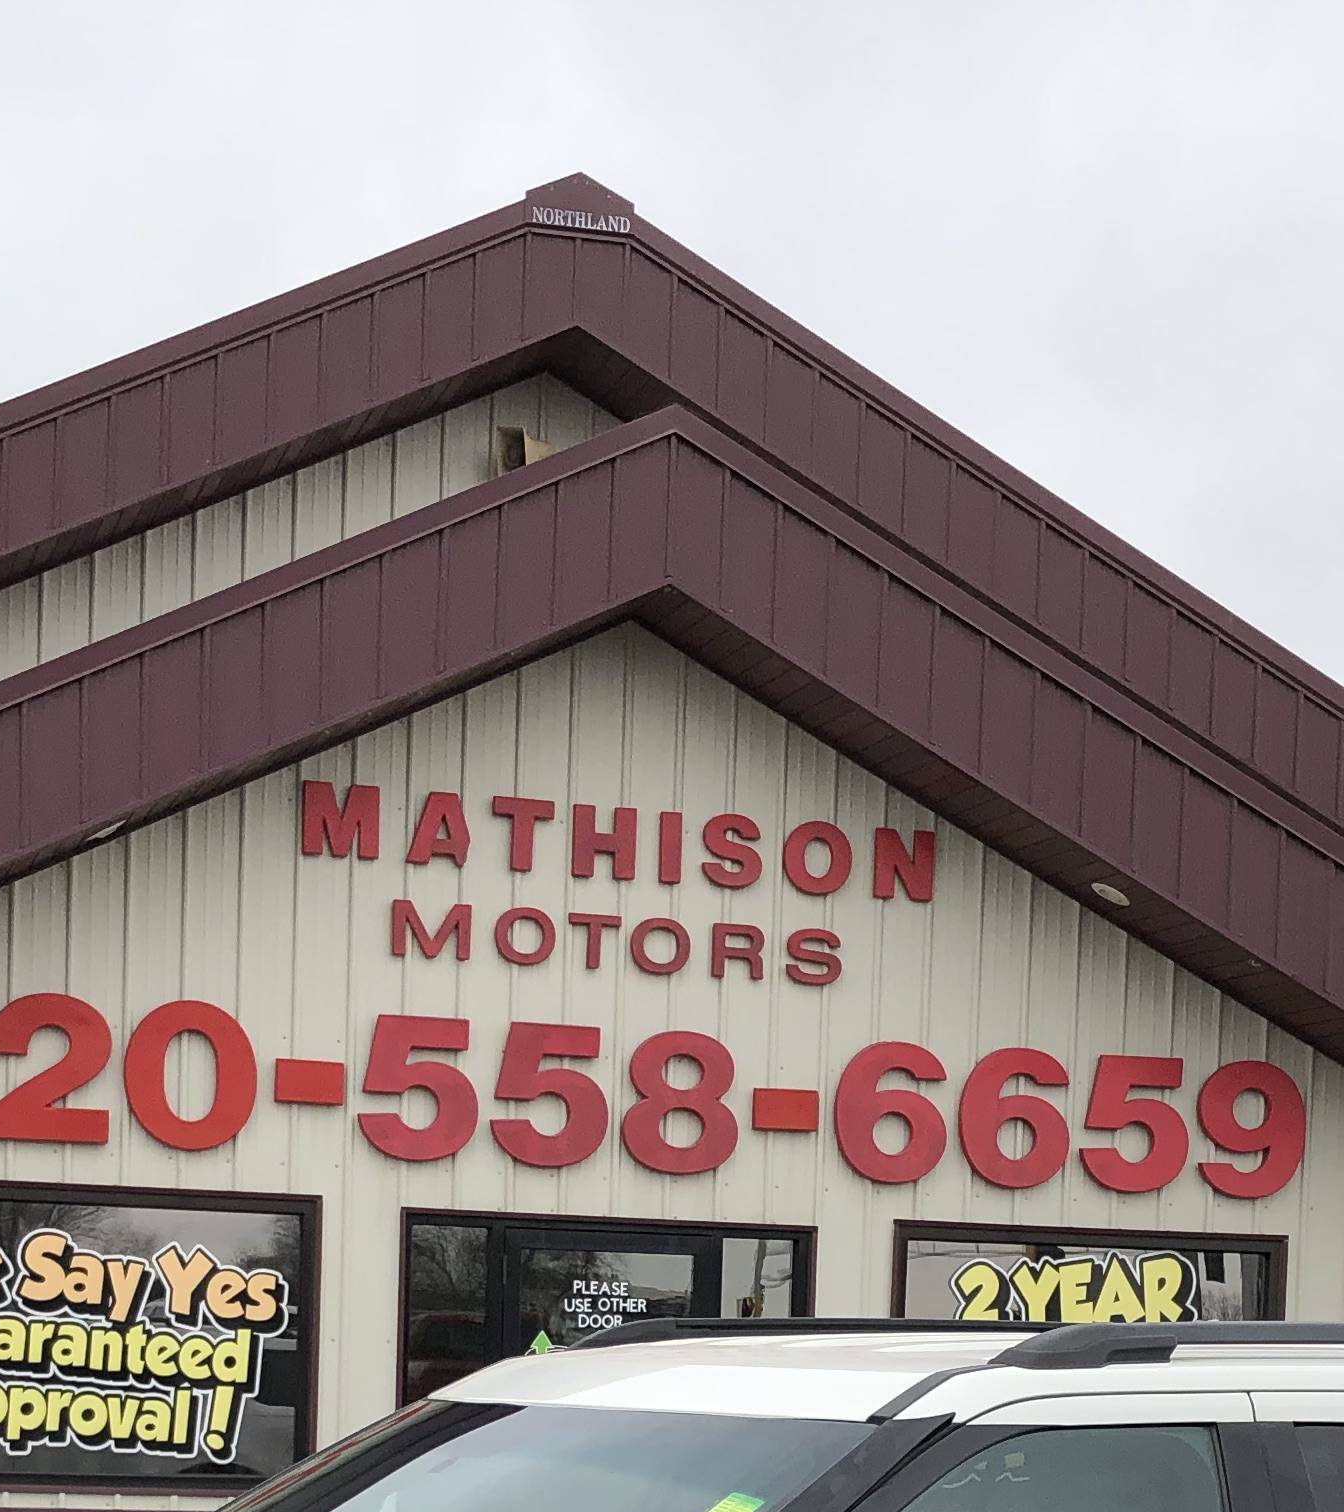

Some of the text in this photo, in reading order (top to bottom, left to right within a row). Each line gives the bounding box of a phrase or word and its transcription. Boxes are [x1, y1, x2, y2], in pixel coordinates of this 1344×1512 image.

[532, 206, 631, 233] NORTHLAND
[301, 780, 936, 904] MATHISON
[390, 899, 843, 986] MOTORS
[17, 1230, 150, 1324] Say
[155, 1243, 286, 1327] Yes
[573, 1280, 629, 1296] PLEASE
[955, 1255, 1190, 1323] 2 YEAR
[564, 1298, 647, 1313] USE OTHER
[578, 1314, 623, 1328] DOOR
